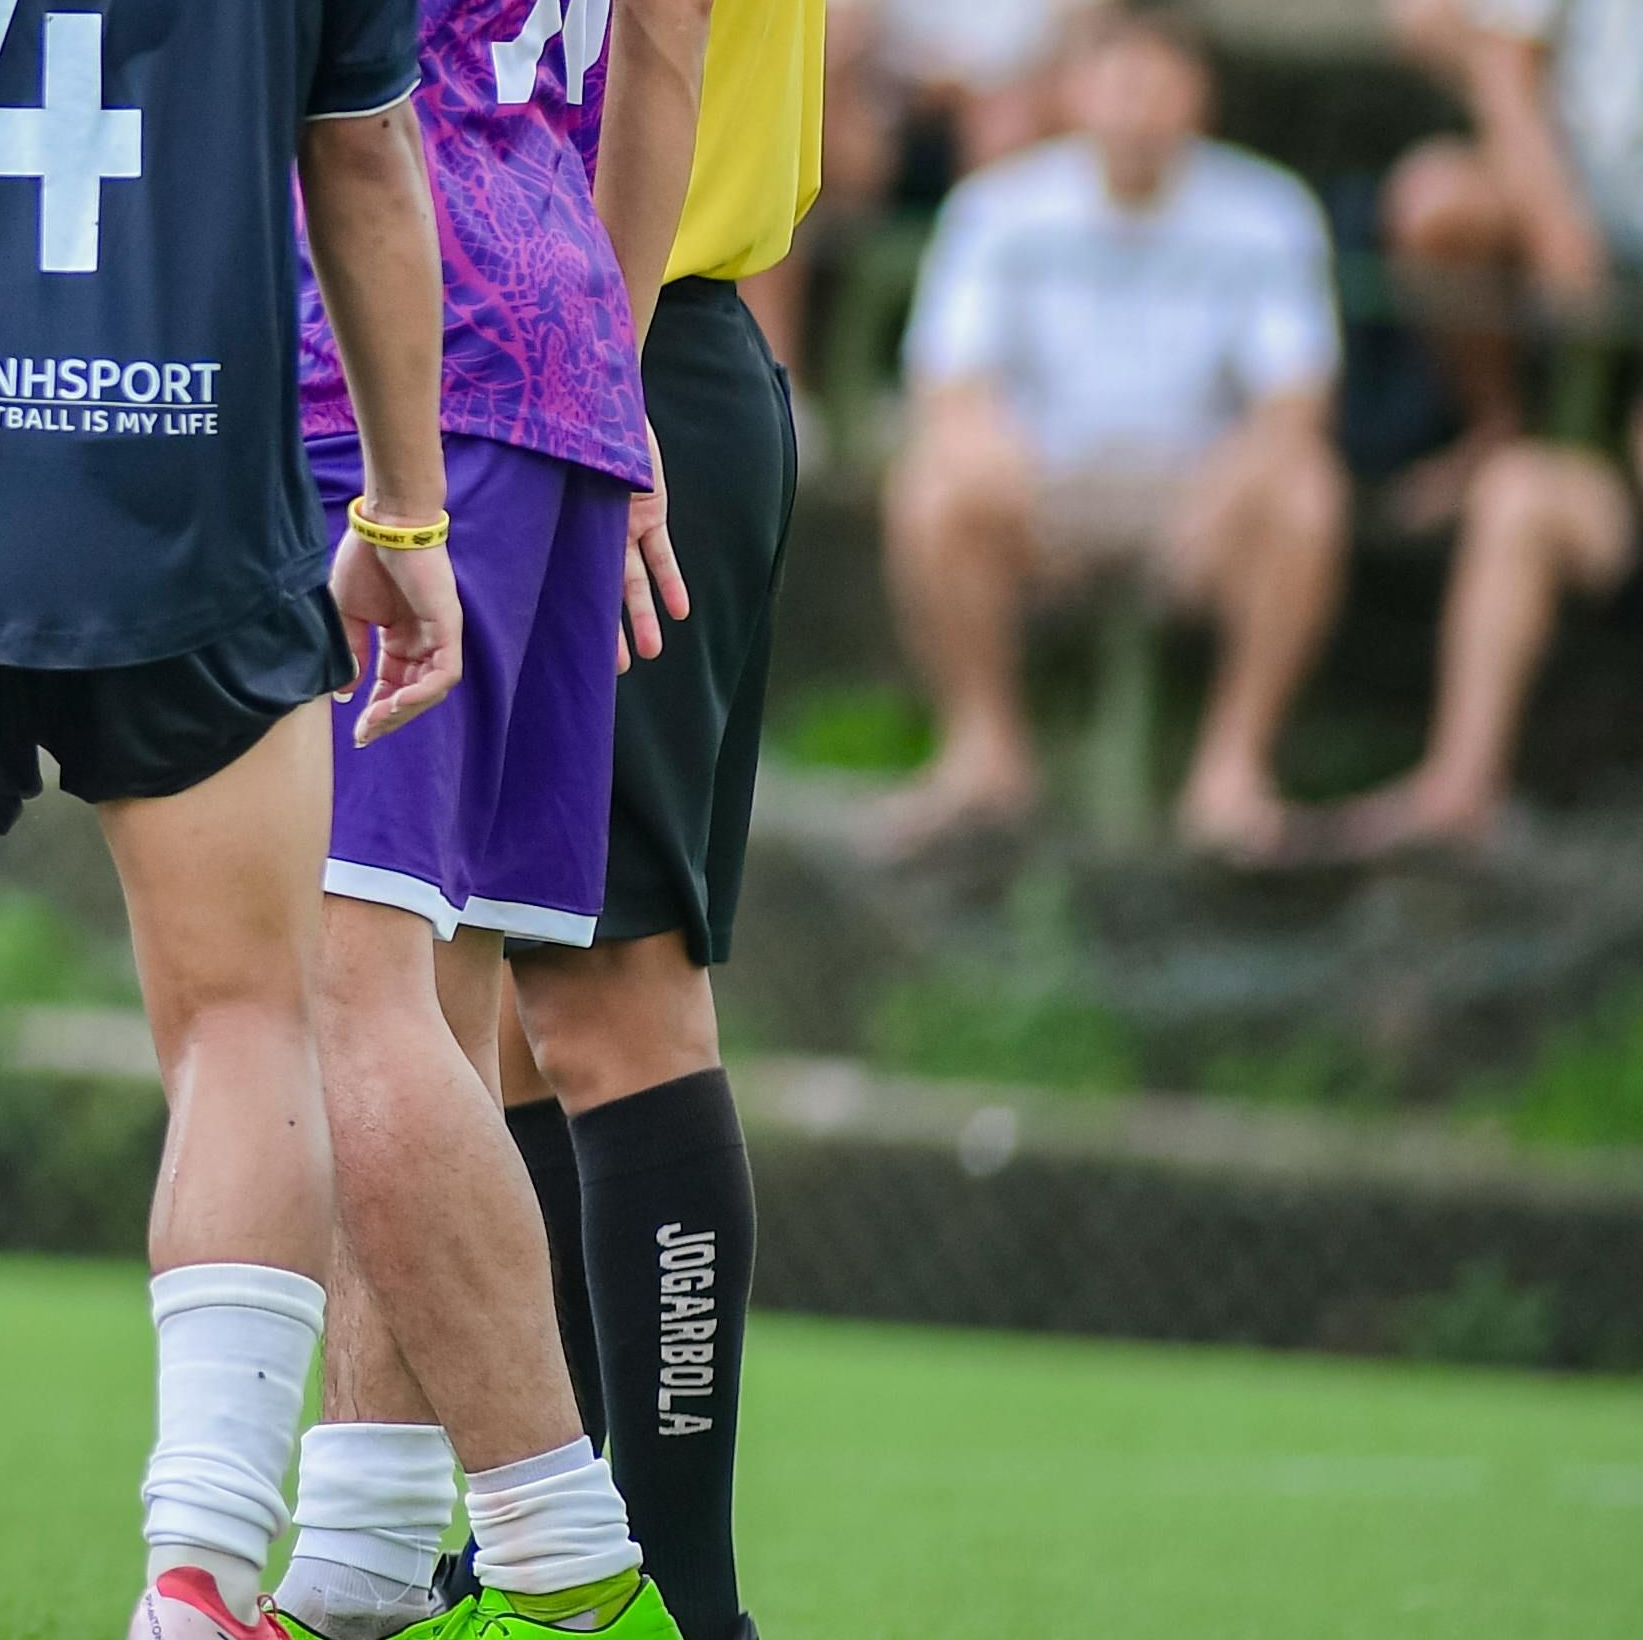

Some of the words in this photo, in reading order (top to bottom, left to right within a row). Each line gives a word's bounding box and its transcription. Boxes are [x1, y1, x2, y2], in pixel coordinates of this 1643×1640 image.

[82, 410, 109, 432] IS
[117, 412, 157, 434] MY
[164, 413, 219, 435] LIFE
[655, 1222, 717, 1436] JOGARBOLA
